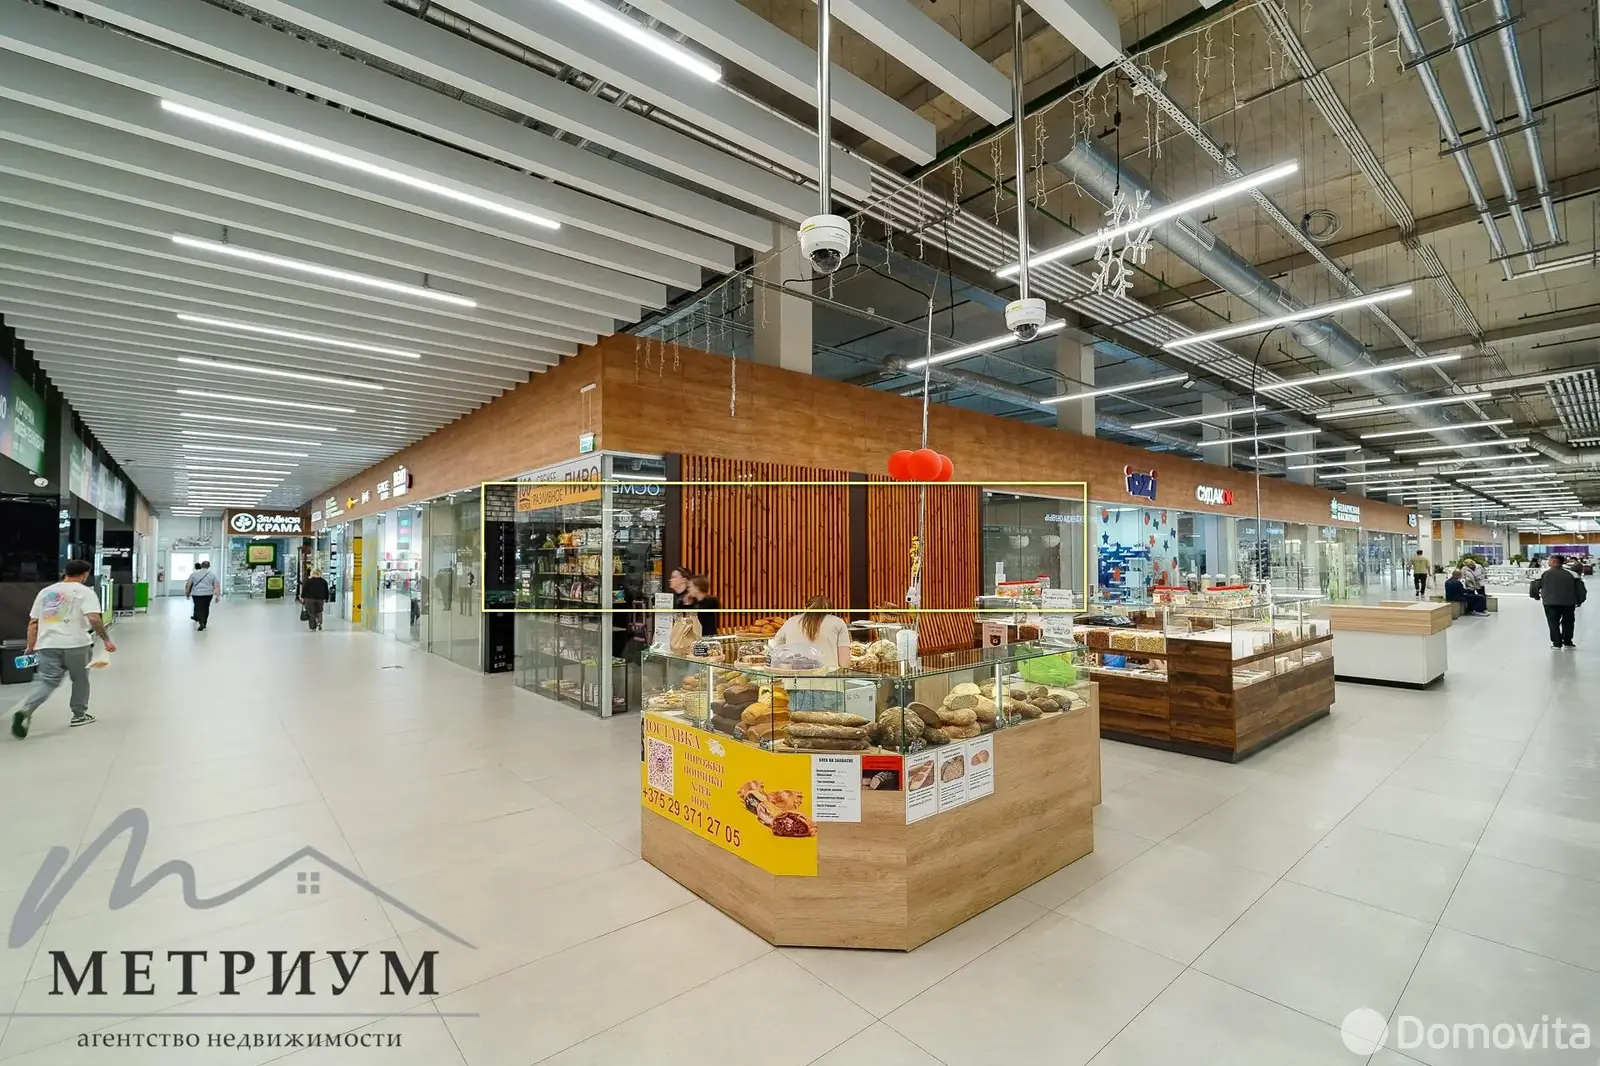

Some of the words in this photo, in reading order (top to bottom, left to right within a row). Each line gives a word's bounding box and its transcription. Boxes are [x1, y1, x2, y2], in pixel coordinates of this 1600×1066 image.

[564, 465, 599, 496] ПИВО
[256, 523, 302, 533] КРАМА
[643, 787, 665, 809] +375
[668, 797, 680, 816] 29
[683, 805, 702, 828] 371
[707, 816, 721, 836] 27
[725, 825, 741, 847] 05
